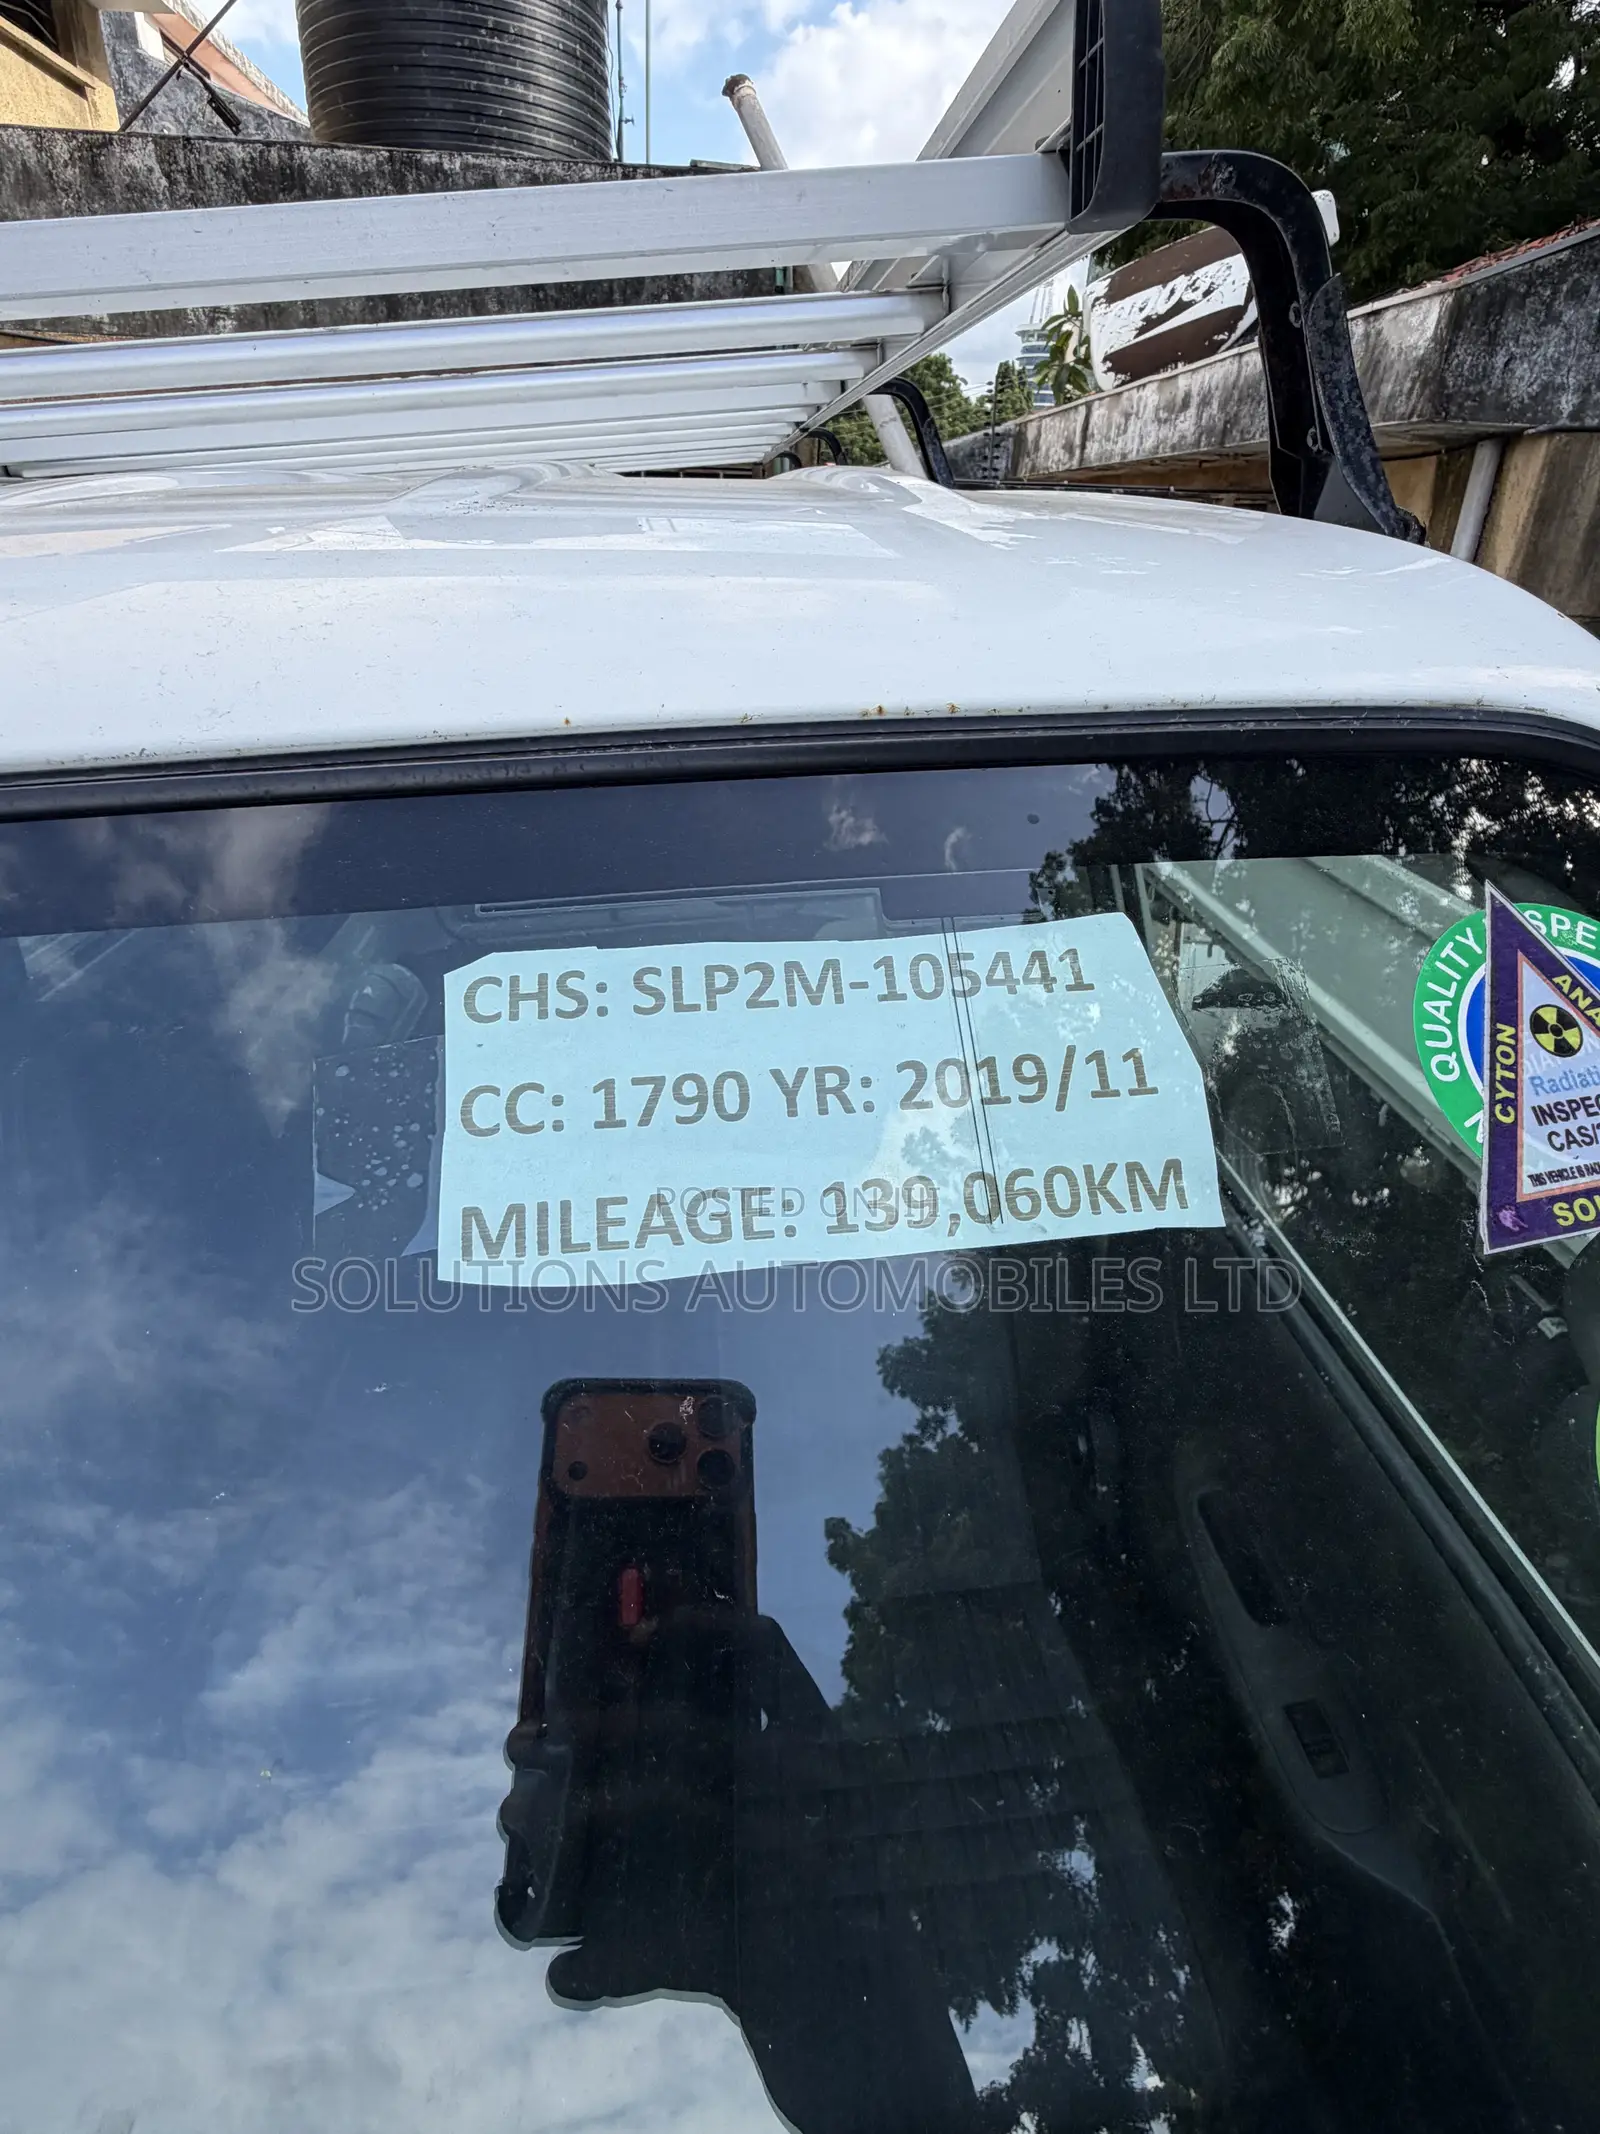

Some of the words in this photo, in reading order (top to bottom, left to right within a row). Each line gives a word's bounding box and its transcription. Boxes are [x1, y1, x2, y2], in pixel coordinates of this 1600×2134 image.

[463, 964, 609, 1024] CHS:
[632, 948, 1096, 1016] SLP2M-105441
[1422, 927, 1483, 1082] QUALITY
[460, 1084, 565, 1137] CC:
[592, 1070, 751, 1129] 1790
[769, 1065, 876, 1118] YR:
[896, 1044, 1159, 1112] 2019/11
[1495, 1023, 1516, 1123] CYTON
[461, 1185, 797, 1262] MILEAGE:
[822, 1158, 1189, 1238] 139,060KM
